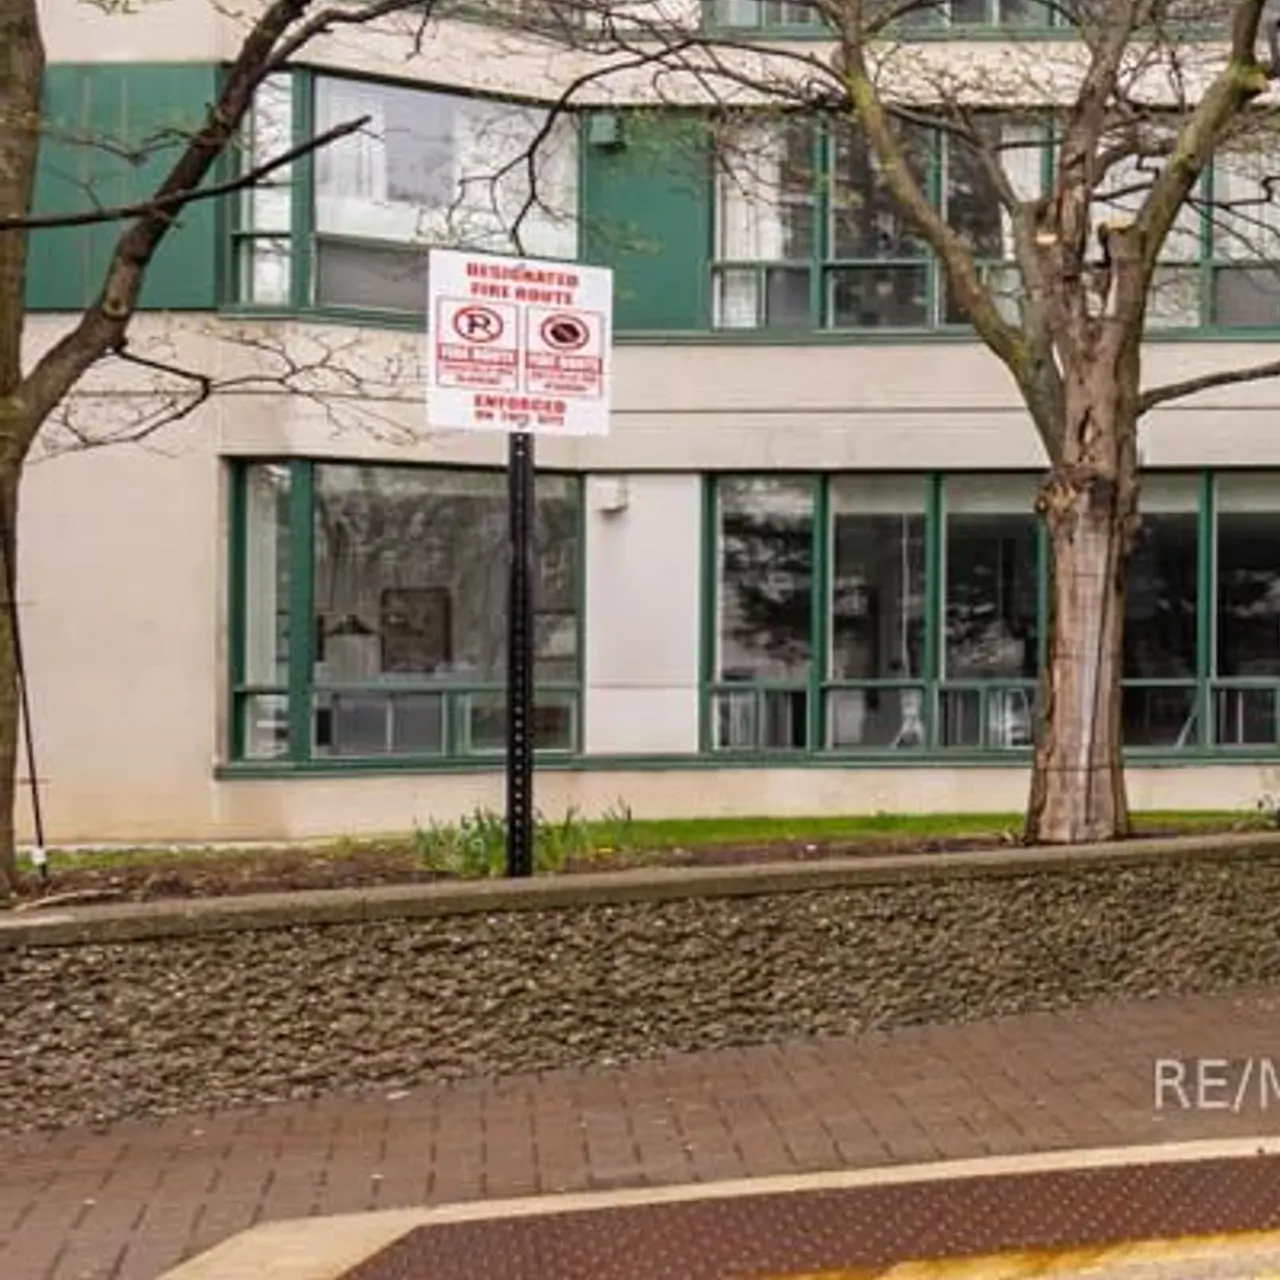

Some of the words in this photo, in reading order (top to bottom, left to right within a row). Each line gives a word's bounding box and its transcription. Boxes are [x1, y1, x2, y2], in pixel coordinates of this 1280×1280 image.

[467, 263, 578, 288] DESIGNATED
[470, 281, 508, 298] FIRE
[515, 287, 573, 305] ROUTE
[474, 394, 567, 414] ENFORCED
